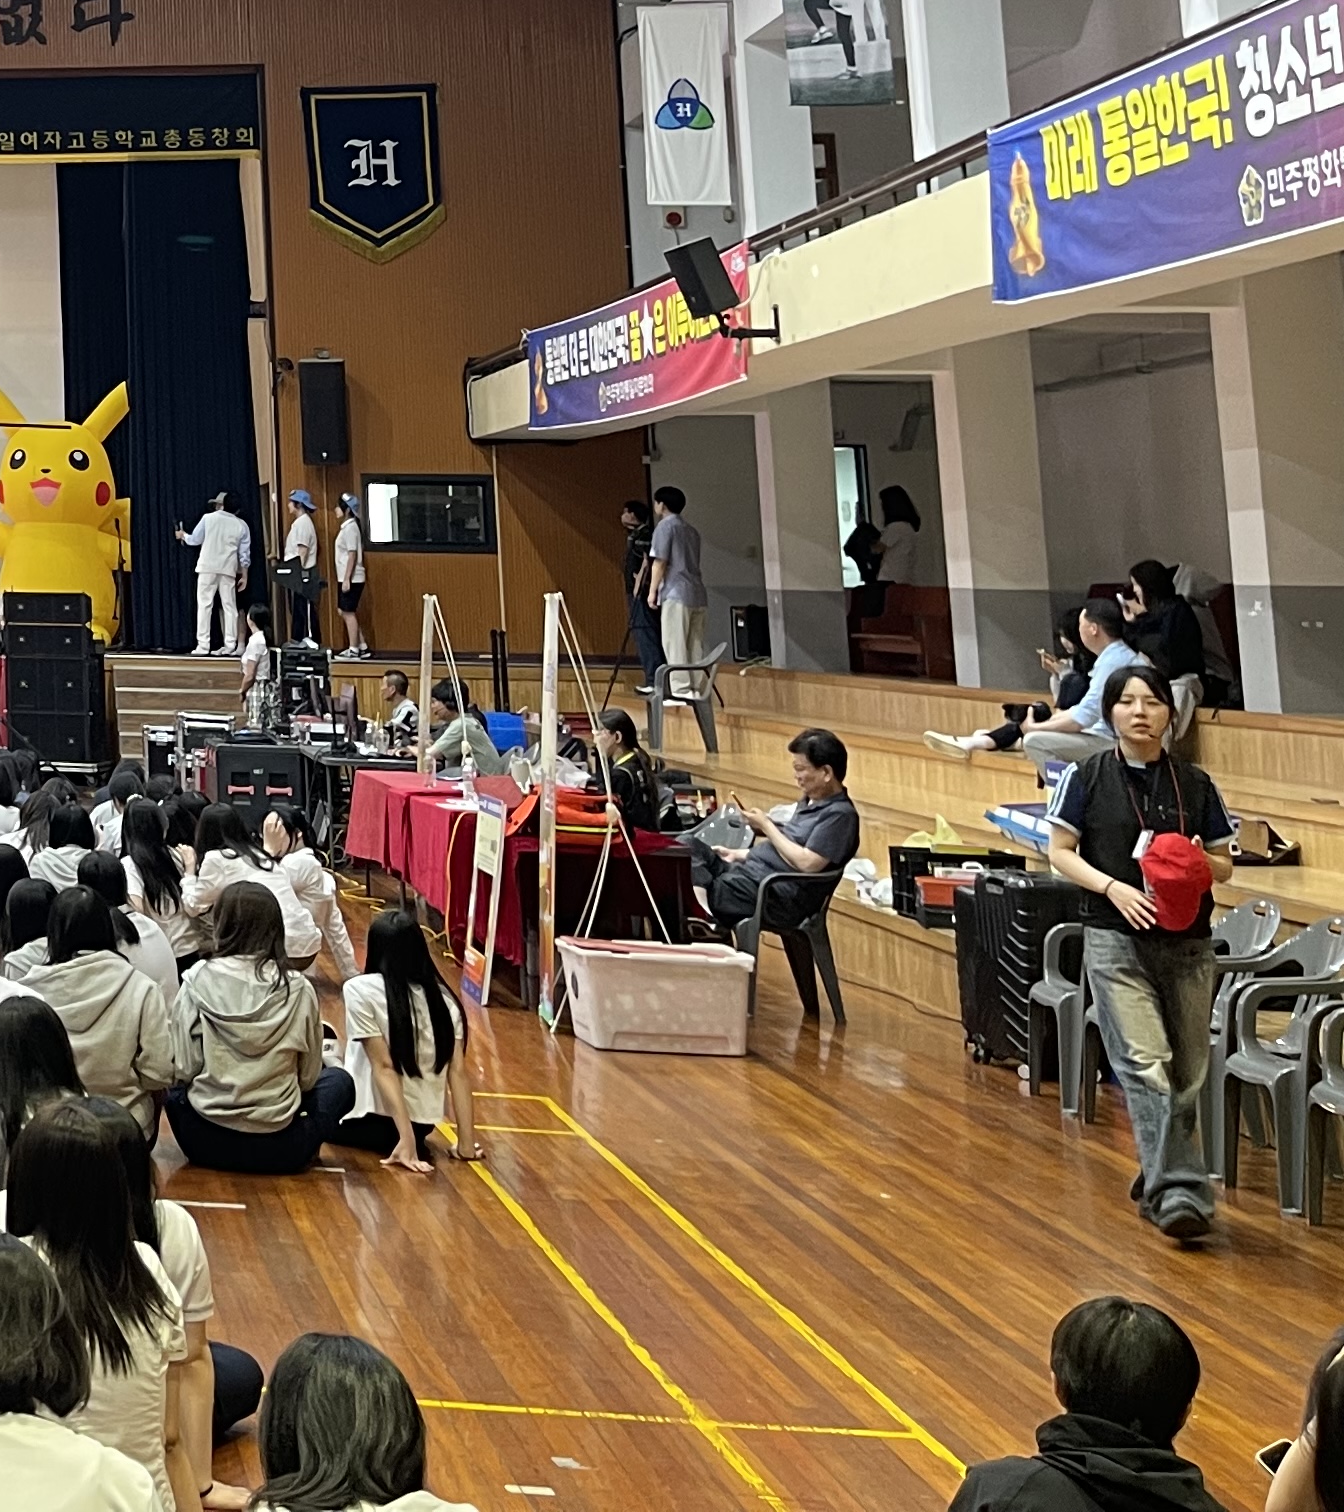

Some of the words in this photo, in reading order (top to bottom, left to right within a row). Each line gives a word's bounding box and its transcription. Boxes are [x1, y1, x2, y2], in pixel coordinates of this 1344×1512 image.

[1039, 109, 1099, 201] 미래
[1097, 54, 1234, 187] 통일한국!
[344, 139, 402, 187] H
[1266, 144, 1344, 208] 민주평화
